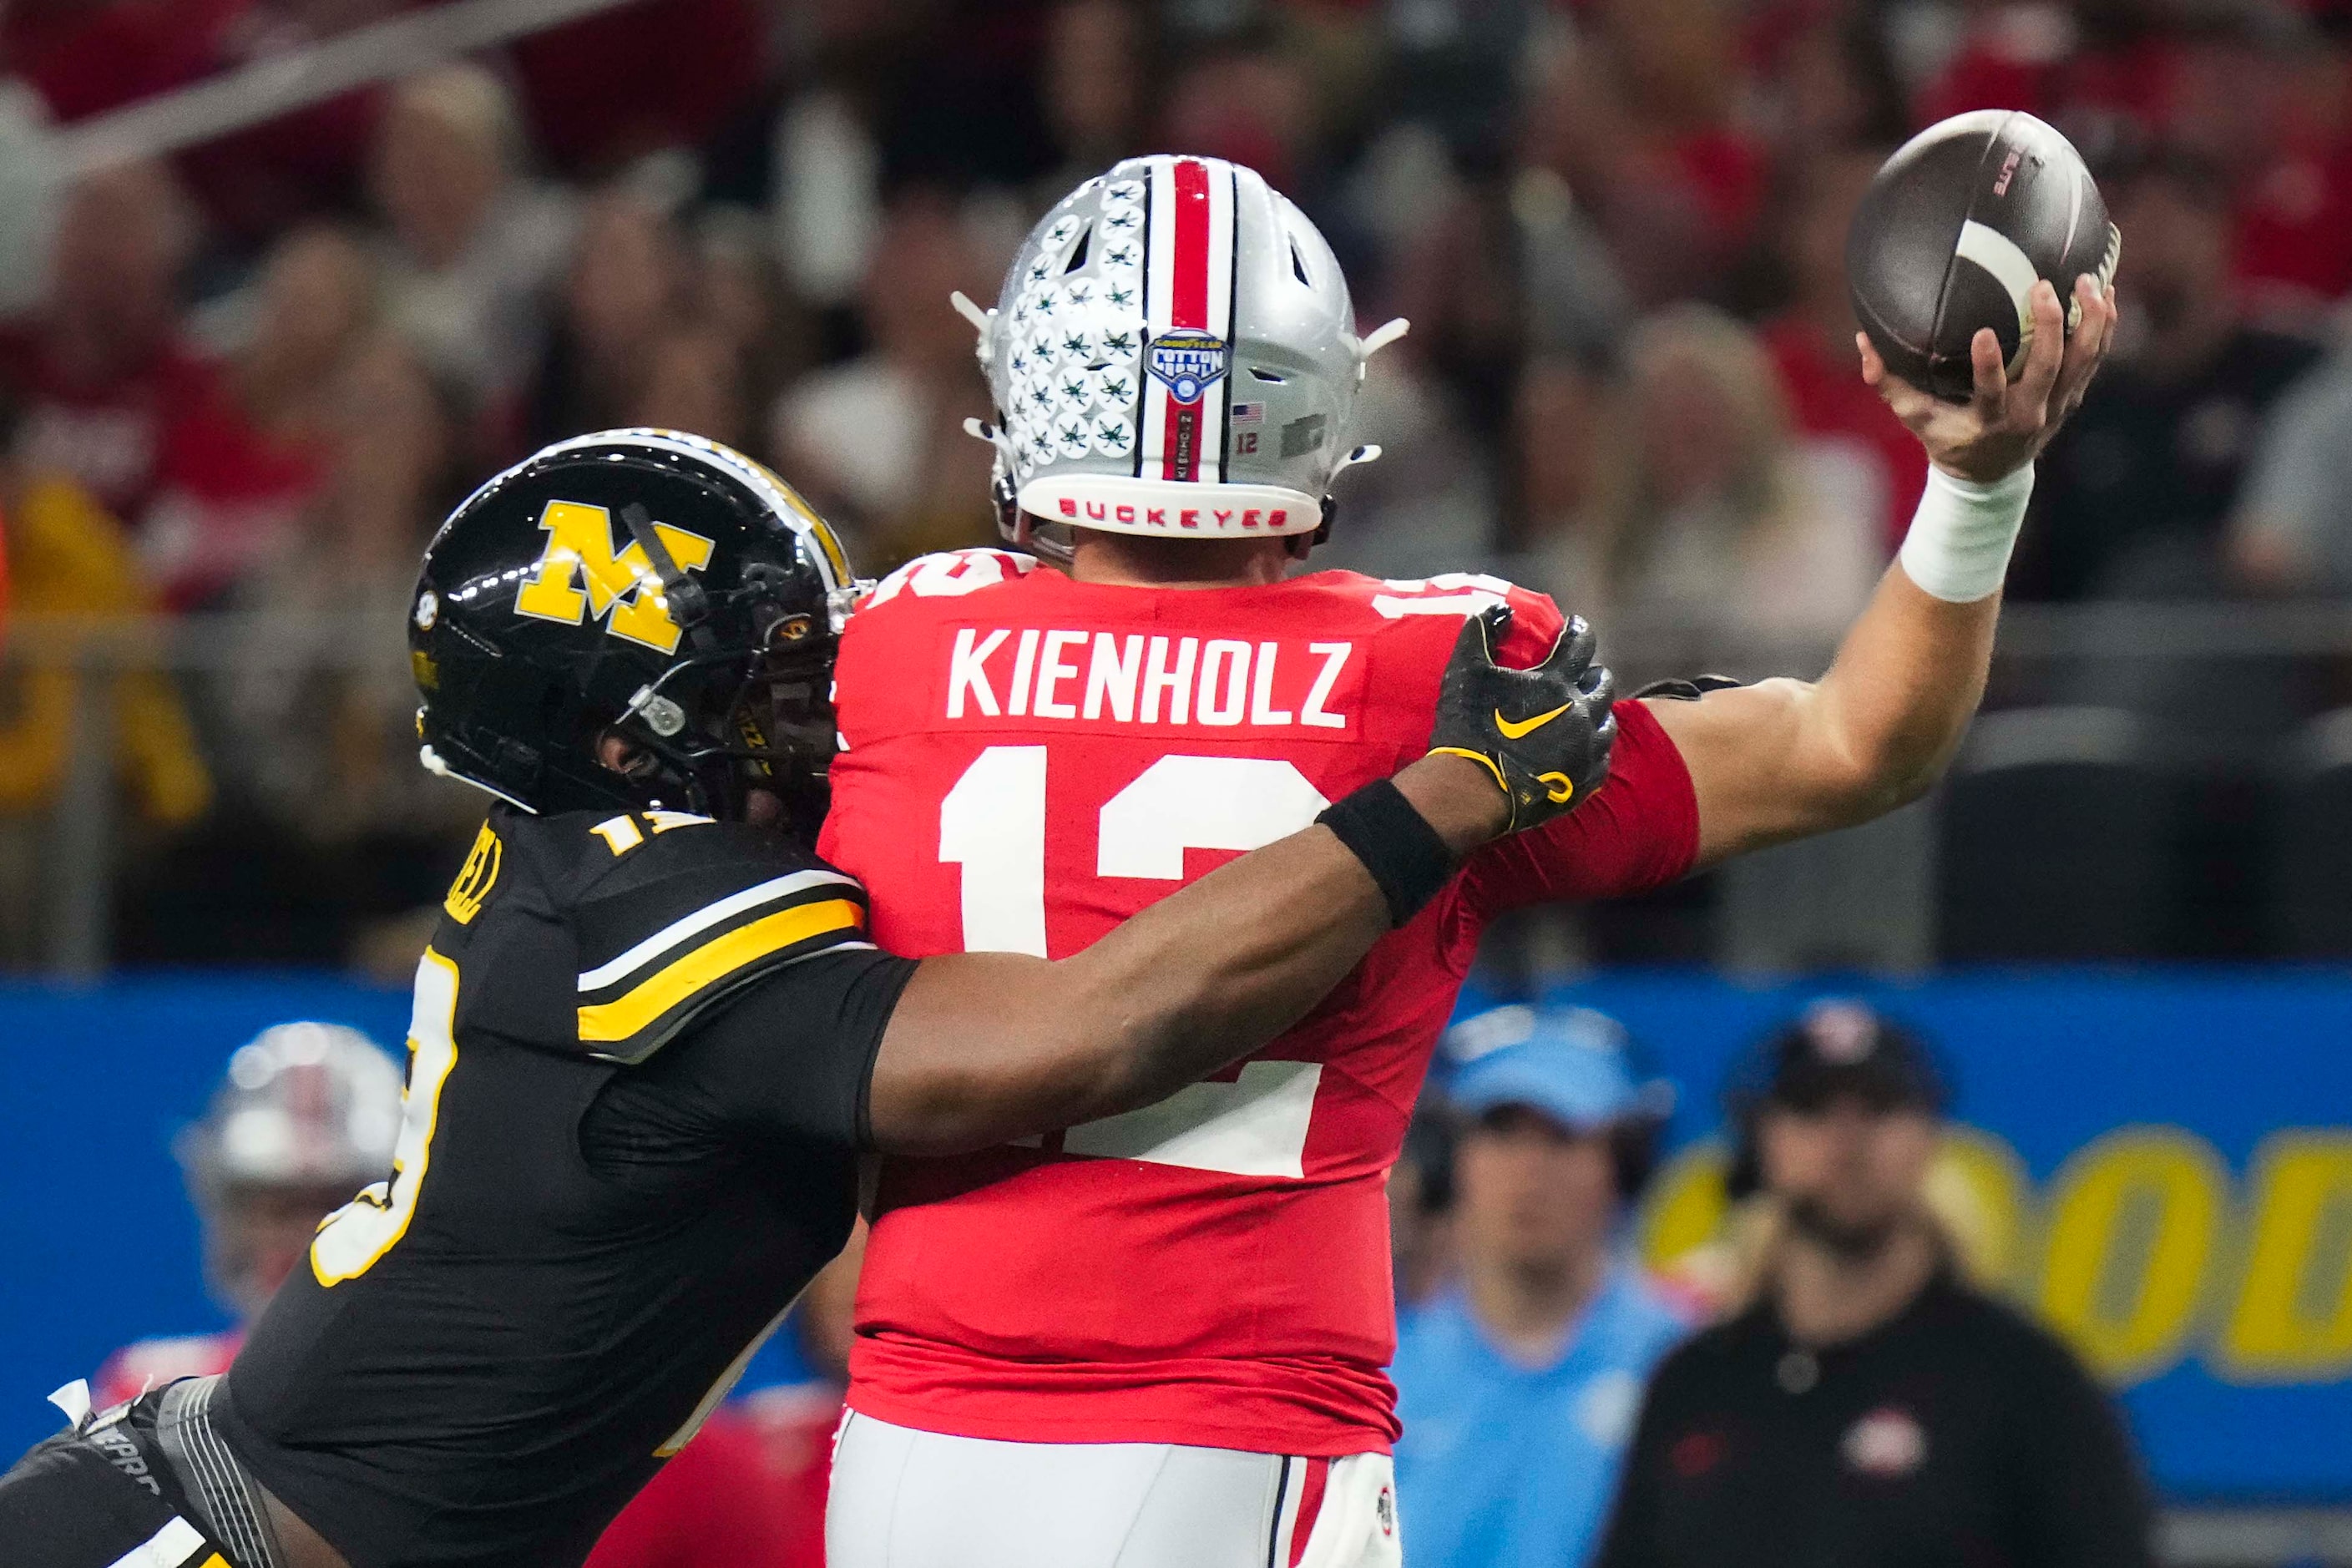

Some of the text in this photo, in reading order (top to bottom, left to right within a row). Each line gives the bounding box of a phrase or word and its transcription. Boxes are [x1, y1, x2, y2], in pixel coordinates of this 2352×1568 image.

[1152, 349, 1224, 371] COTTON
[1237, 432, 1257, 455] 12
[1059, 498, 1288, 529] BUCKEYES
[513, 498, 716, 656] M
[946, 628, 1353, 729] KIENHOLZ
